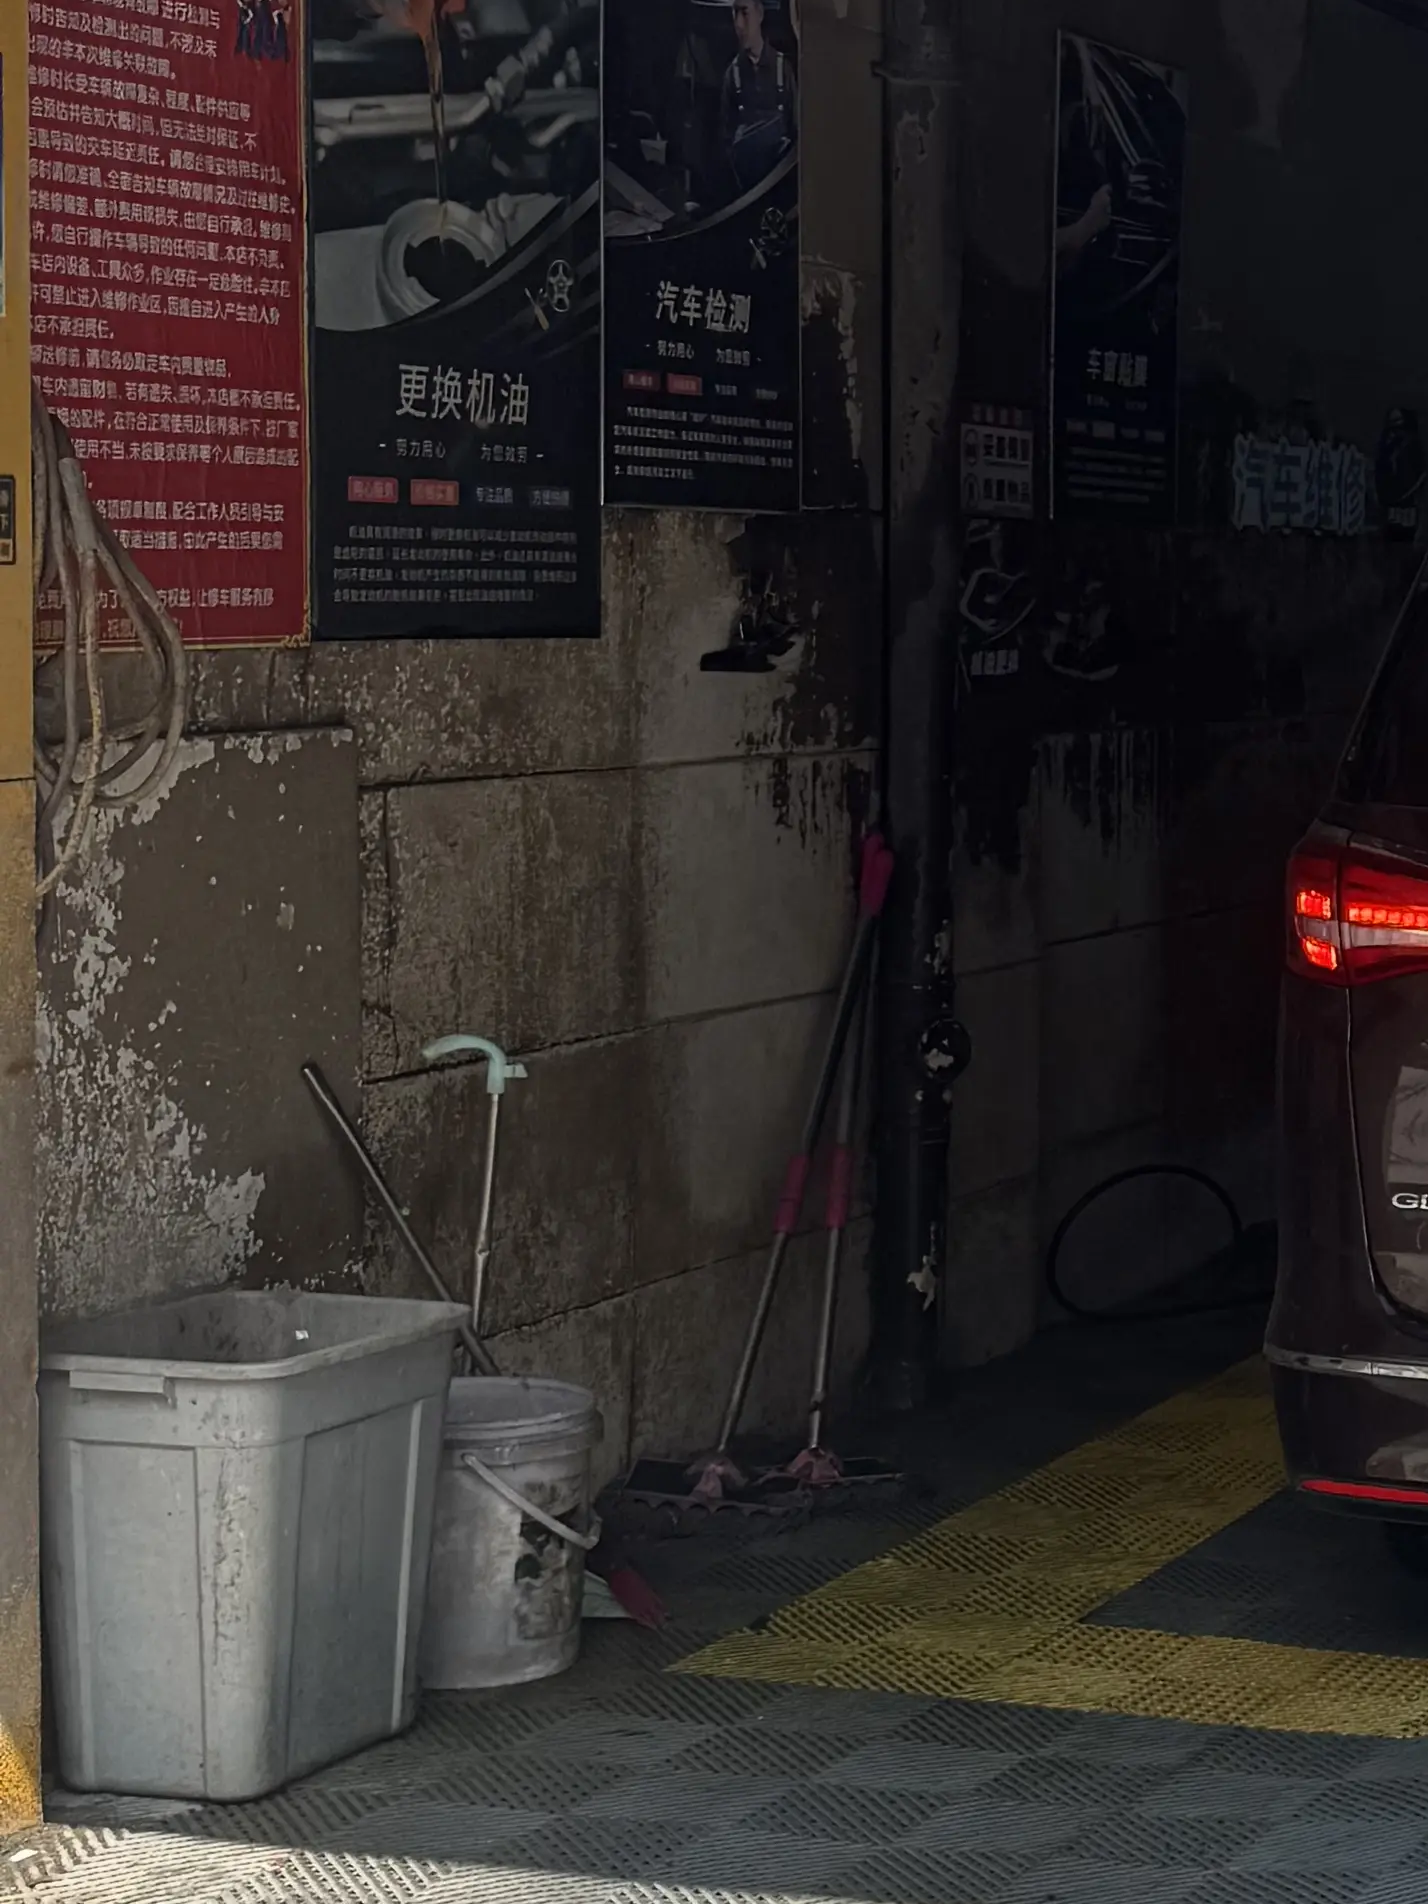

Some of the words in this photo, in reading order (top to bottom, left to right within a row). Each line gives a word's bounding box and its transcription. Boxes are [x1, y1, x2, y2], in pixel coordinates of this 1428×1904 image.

[656, 280, 752, 334] 汽车检测
[395, 363, 530, 427] 更换机油
[1233, 431, 1366, 536] 汽车维修
